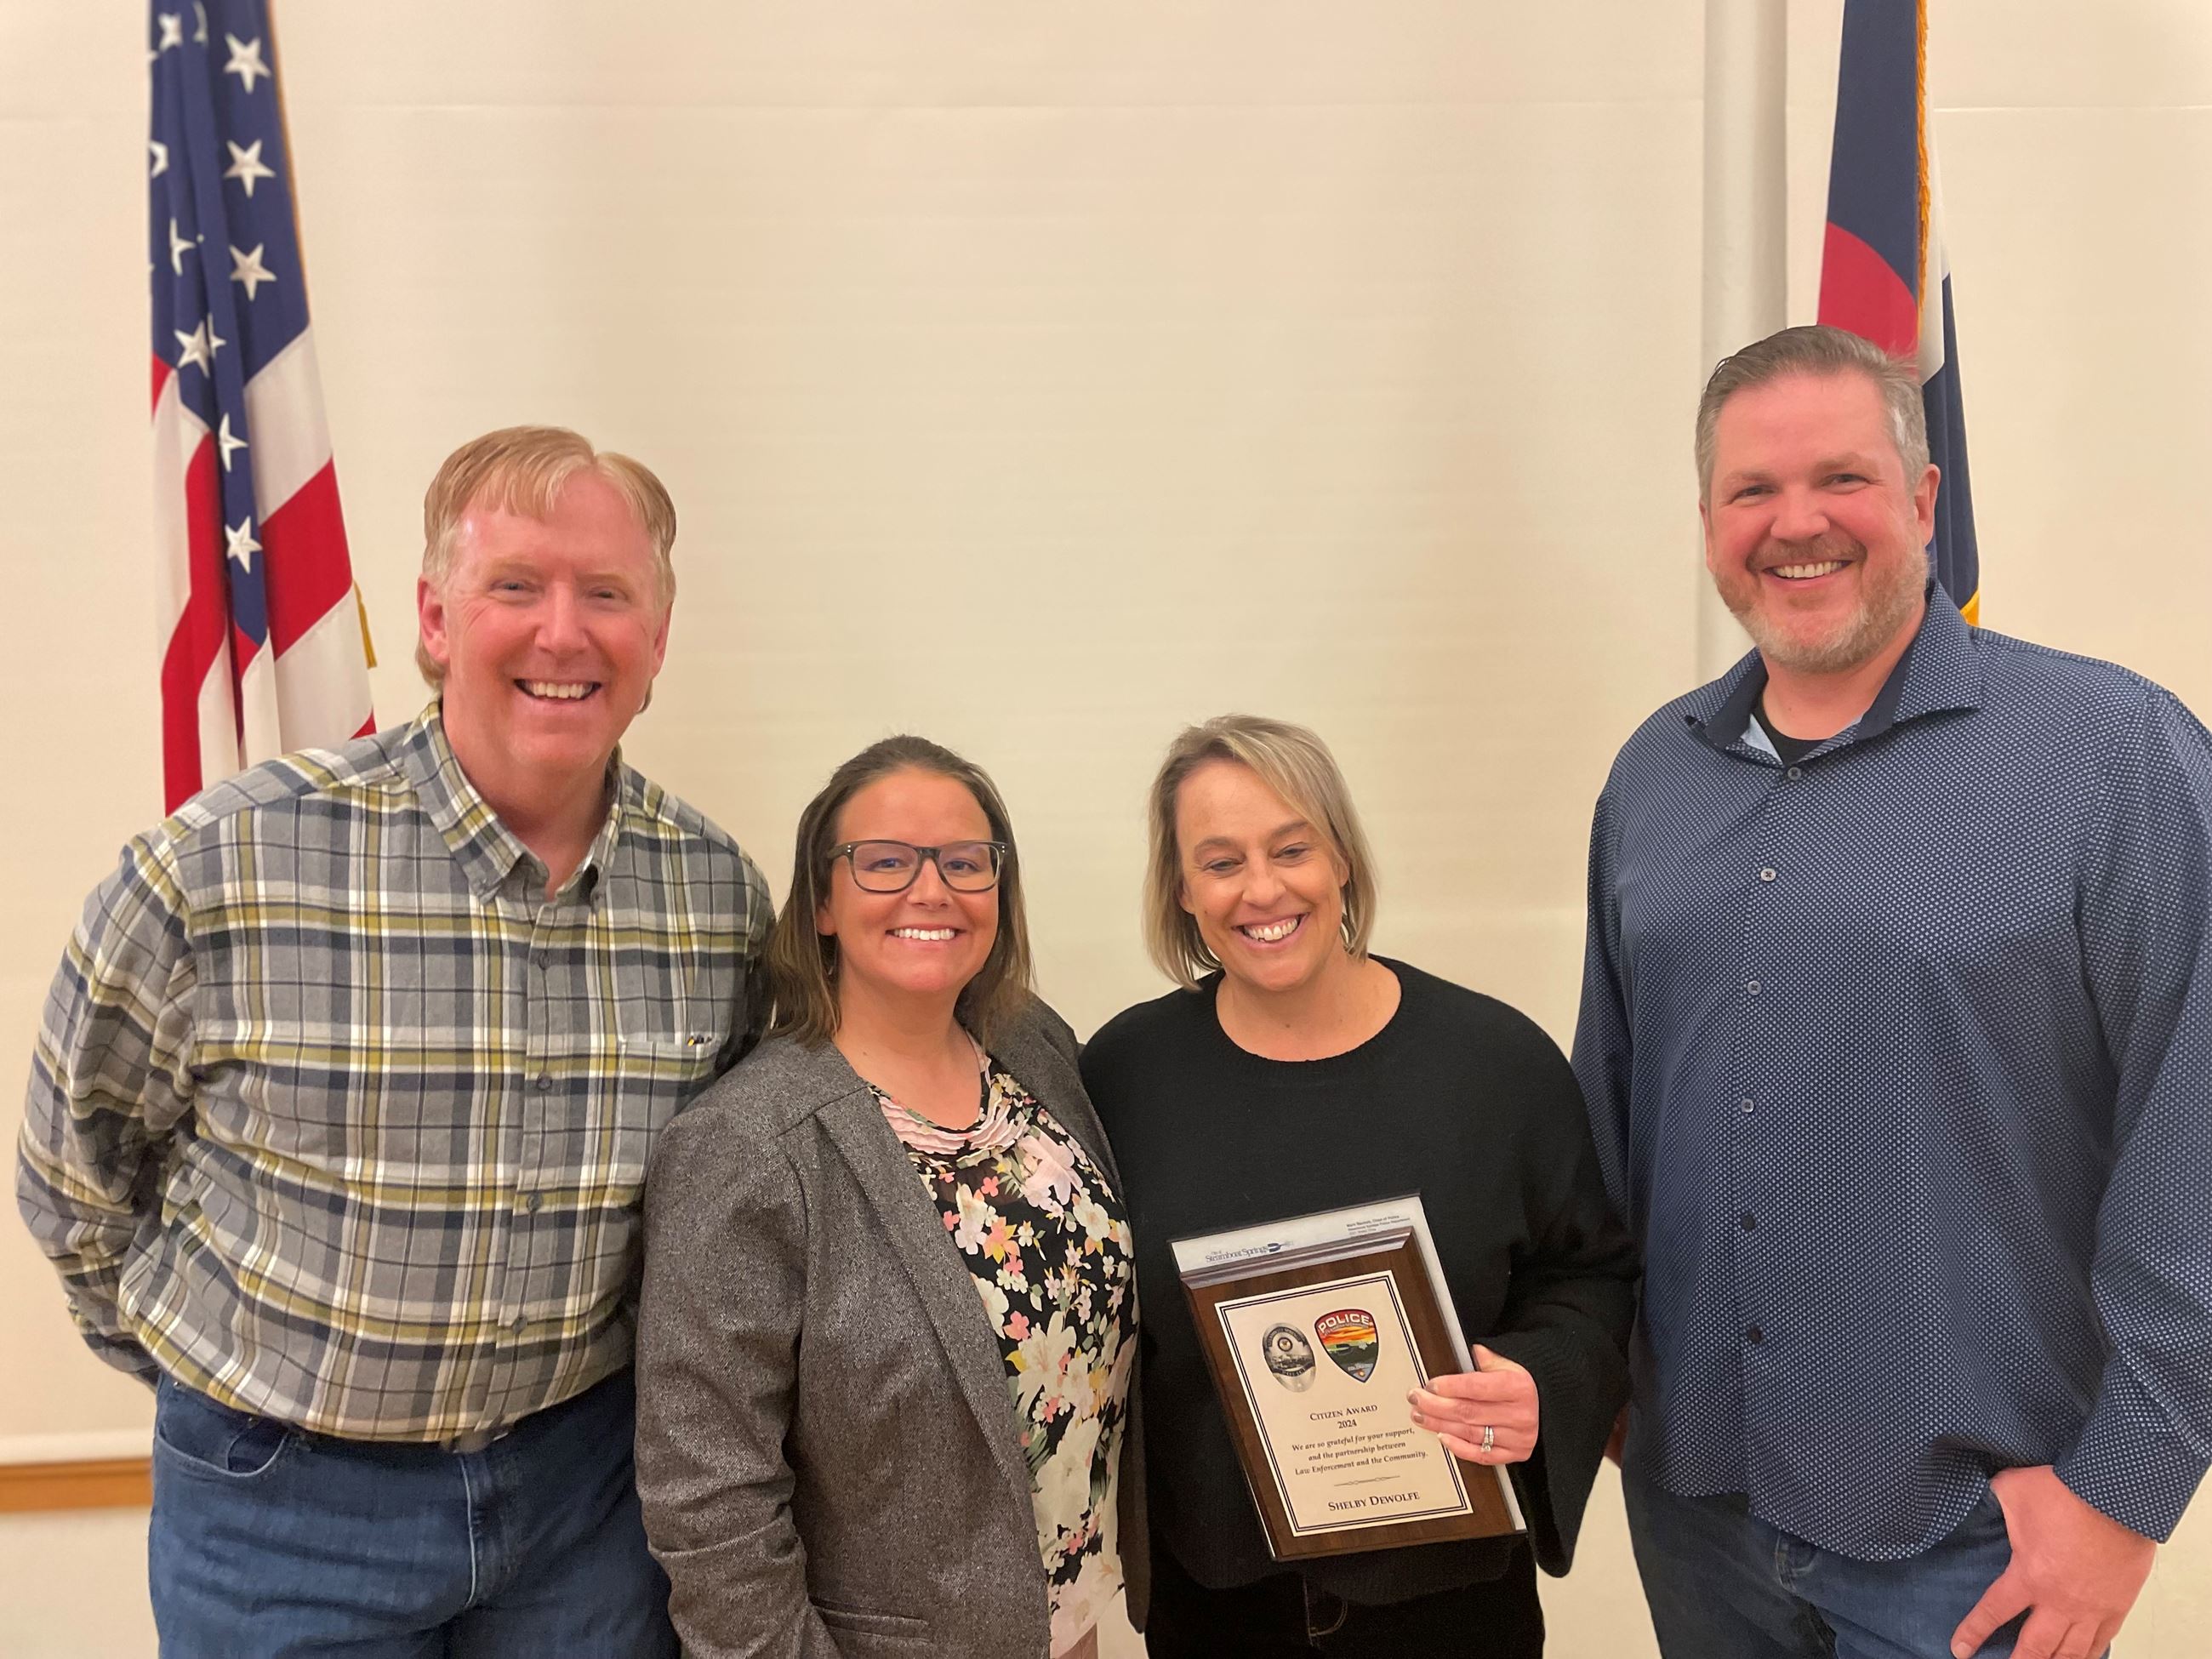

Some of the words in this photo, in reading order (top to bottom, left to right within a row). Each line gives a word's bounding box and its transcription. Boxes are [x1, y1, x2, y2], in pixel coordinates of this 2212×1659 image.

[1318, 1314, 1370, 1333] POLICE
[1309, 1409, 1343, 1421] CITIZEN
[1346, 1405, 1378, 1417] AWARD
[1337, 1419, 1358, 1429] 2024
[1326, 1435, 1354, 1449] grateful
[1354, 1434, 1365, 1445] for
[1366, 1433, 1383, 1443] your
[1385, 1428, 1415, 1440] support,
[1322, 1451, 1334, 1459] the
[1335, 1445, 1376, 1460] partnership
[1377, 1441, 1406, 1451] between
[1295, 1467, 1311, 1476] Law
[1312, 1461, 1354, 1474] Enforcement
[1355, 1458, 1370, 1467] and
[1328, 1497, 1367, 1512] SHELBY
